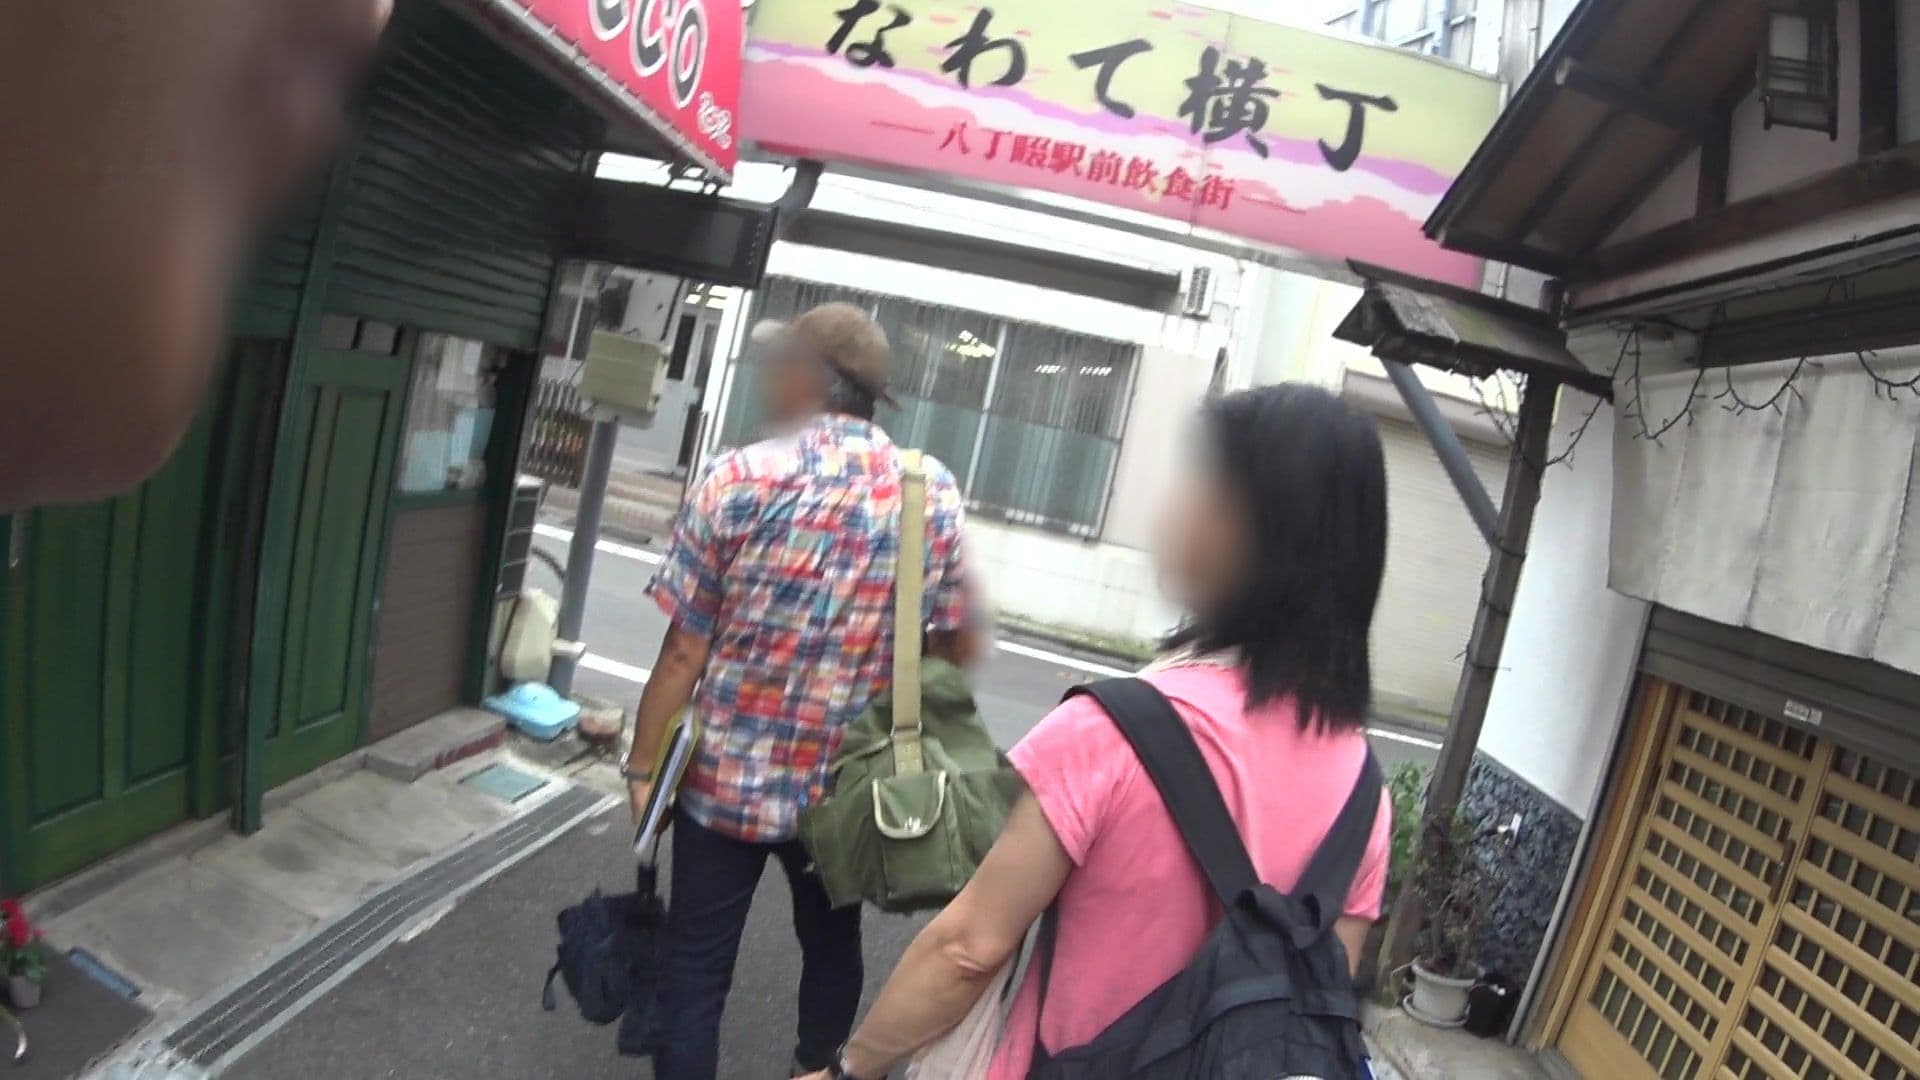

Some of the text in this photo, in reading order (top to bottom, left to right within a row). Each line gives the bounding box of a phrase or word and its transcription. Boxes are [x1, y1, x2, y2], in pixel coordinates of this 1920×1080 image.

[826, 0, 1398, 172] なわて横丁
